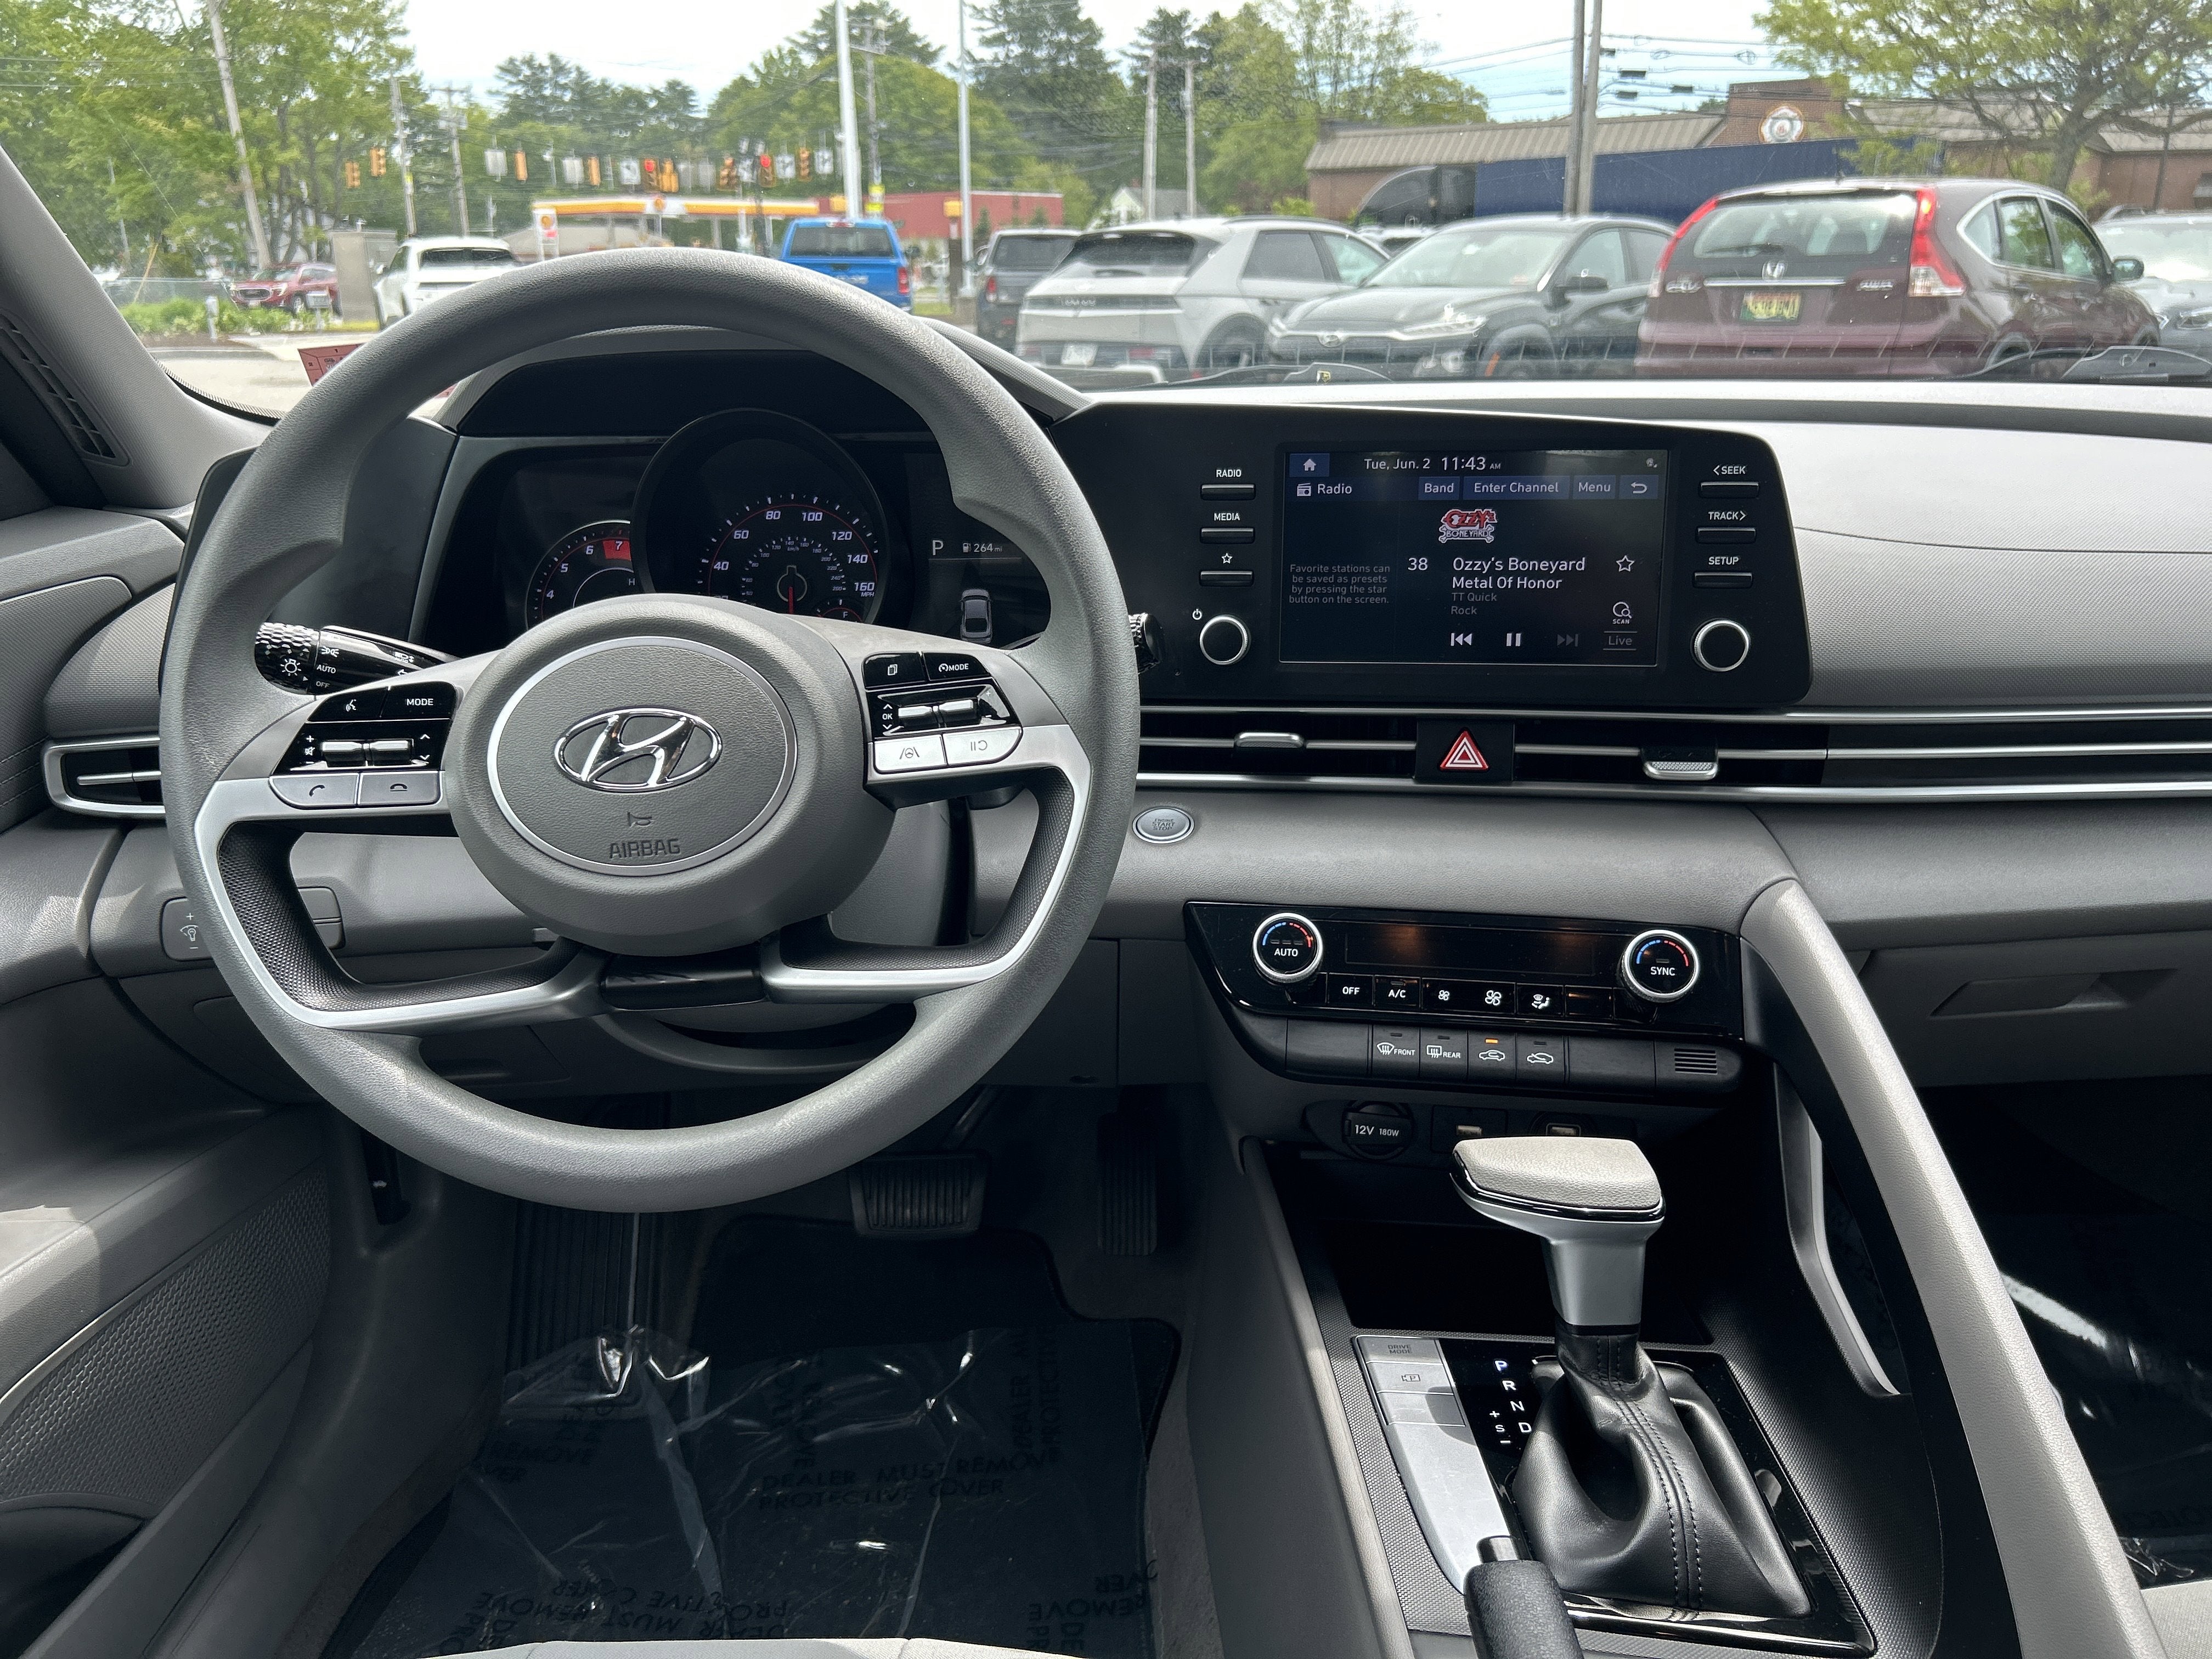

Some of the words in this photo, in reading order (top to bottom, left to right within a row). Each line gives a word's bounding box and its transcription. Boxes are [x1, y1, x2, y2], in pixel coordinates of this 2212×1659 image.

[1364, 459, 1390, 470] Tue,
[1393, 459, 1419, 469] Jun.
[1423, 458, 1431, 469] 2
[1442, 457, 1486, 470] 11:43
[1216, 469, 1242, 477] RADIO
[1721, 466, 1746, 475] SEEK
[1318, 483, 1352, 494] Radio
[1424, 483, 1454, 493] Band
[1474, 482, 1506, 493] Enter
[1510, 482, 1559, 493] Channel
[1578, 482, 1611, 492] Menu
[765, 511, 781, 520] 80
[802, 512, 823, 521] 100
[1214, 512, 1240, 521] MEDIA
[1708, 511, 1739, 520] TRACK
[733, 530, 749, 539] 60
[832, 531, 853, 540] 120
[585, 545, 594, 555] 6
[615, 541, 623, 550] 7
[933, 540, 944, 556] P
[974, 543, 993, 552] 264
[847, 554, 868, 564] 140
[1408, 557, 1427, 571] 38
[1708, 556, 1739, 565] SETUP
[560, 563, 568, 573] 5
[713, 561, 729, 571] 40
[1290, 564, 1329, 573] Favorite
[1331, 564, 1370, 573] stations
[1453, 557, 1503, 573] Ozzy's
[1509, 557, 1585, 573] Boneyard
[1292, 575, 1304, 583] be
[1306, 575, 1334, 583] saved
[1351, 575, 1387, 584] presets
[1452, 576, 1492, 589] Metal
[1497, 577, 1513, 589] Of
[1517, 577, 1562, 589] Honor
[854, 582, 875, 591] 160
[1291, 585, 1302, 595] by
[1306, 585, 1346, 595] pressing
[546, 590, 554, 599] 4
[1289, 595, 1319, 603] button
[1336, 595, 1352, 603] the
[1451, 592, 1465, 602] TT
[1467, 592, 1497, 602] Quick
[1451, 606, 1477, 615] Rock
[1609, 636, 1633, 646] Live
[317, 664, 336, 674] AUTO
[949, 663, 969, 672] MODE
[609, 838, 681, 859] AIRBAG
[1274, 948, 1299, 957] AUTO
[1650, 966, 1675, 976] SYNC
[1342, 986, 1360, 995] OFF
[1388, 989, 1406, 998] A/C
[1355, 1125, 1374, 1136] 12V
[1379, 1128, 1400, 1137] 180W
[1494, 1361, 1508, 1372] P
[1502, 1380, 1516, 1391] R
[1510, 1401, 1525, 1412] N
[1496, 1424, 1505, 1432] S
[1519, 1422, 1532, 1433] D
